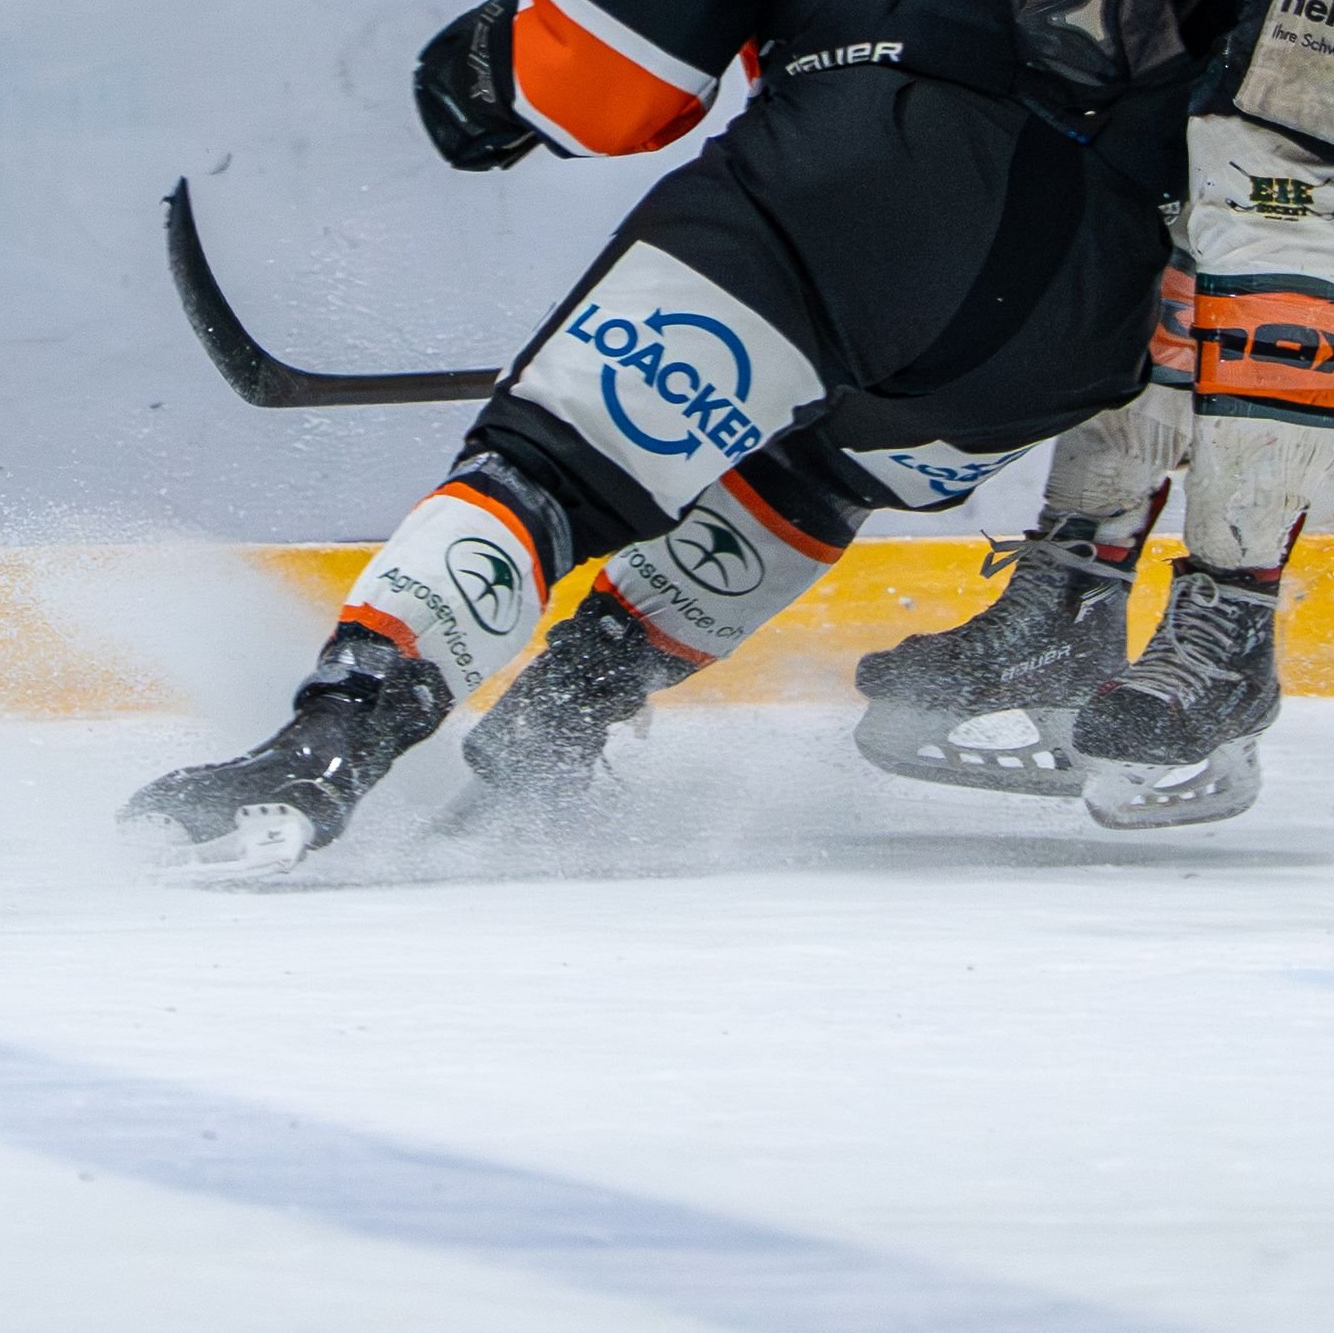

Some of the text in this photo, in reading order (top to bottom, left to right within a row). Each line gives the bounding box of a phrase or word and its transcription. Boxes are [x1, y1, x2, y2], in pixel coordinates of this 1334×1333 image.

[1272, 24, 1298, 44] Ihre
[1249, 175, 1315, 205] EIE
[566, 303, 762, 464] LOACKER
